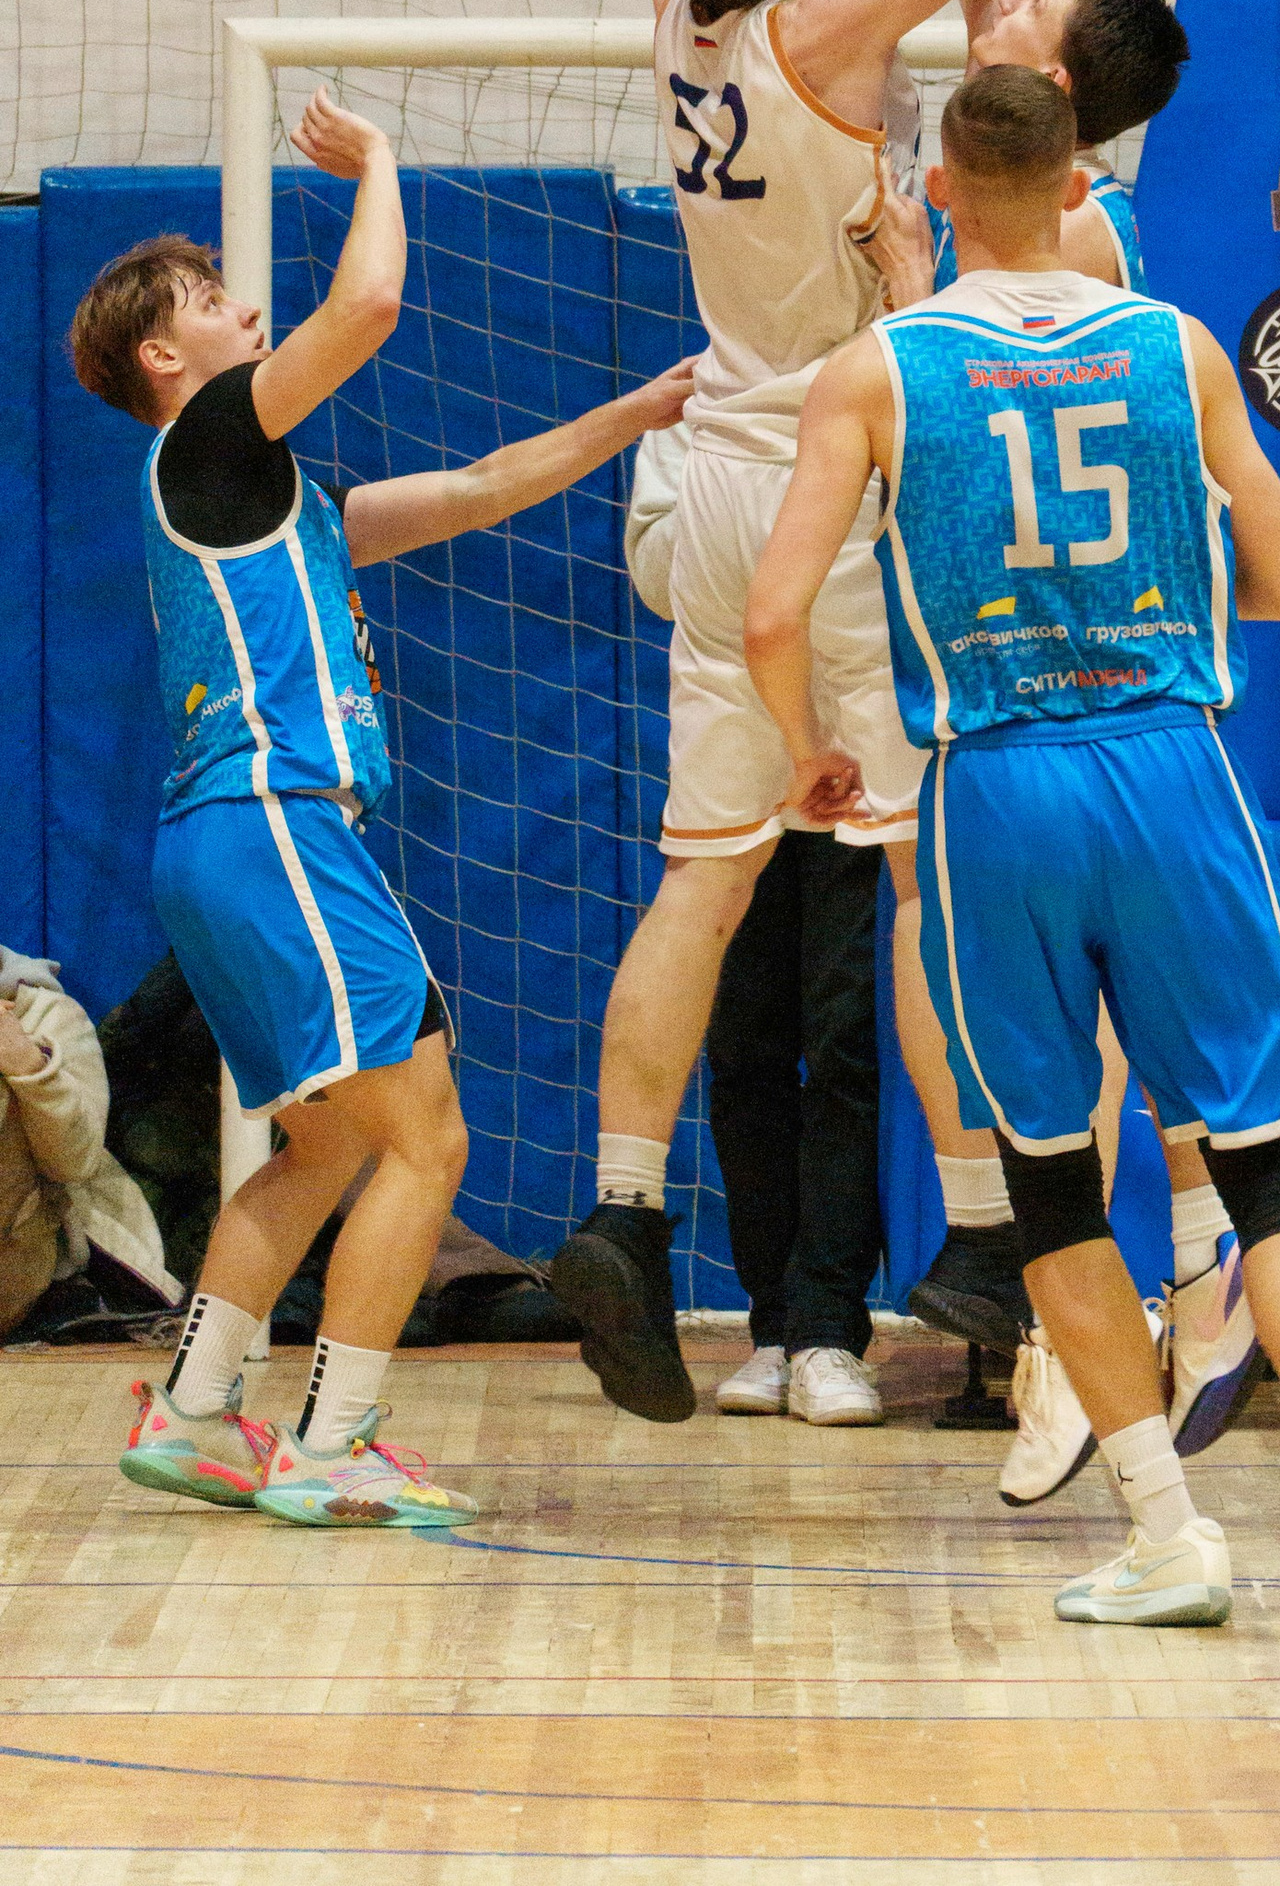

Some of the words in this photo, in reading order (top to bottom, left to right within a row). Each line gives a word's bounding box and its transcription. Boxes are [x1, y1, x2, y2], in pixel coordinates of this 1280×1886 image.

[967, 358, 1131, 389] ЭНЕРГОГАРАНТ
[987, 400, 1131, 570] 15
[946, 623, 1069, 654] аксвичкоф
